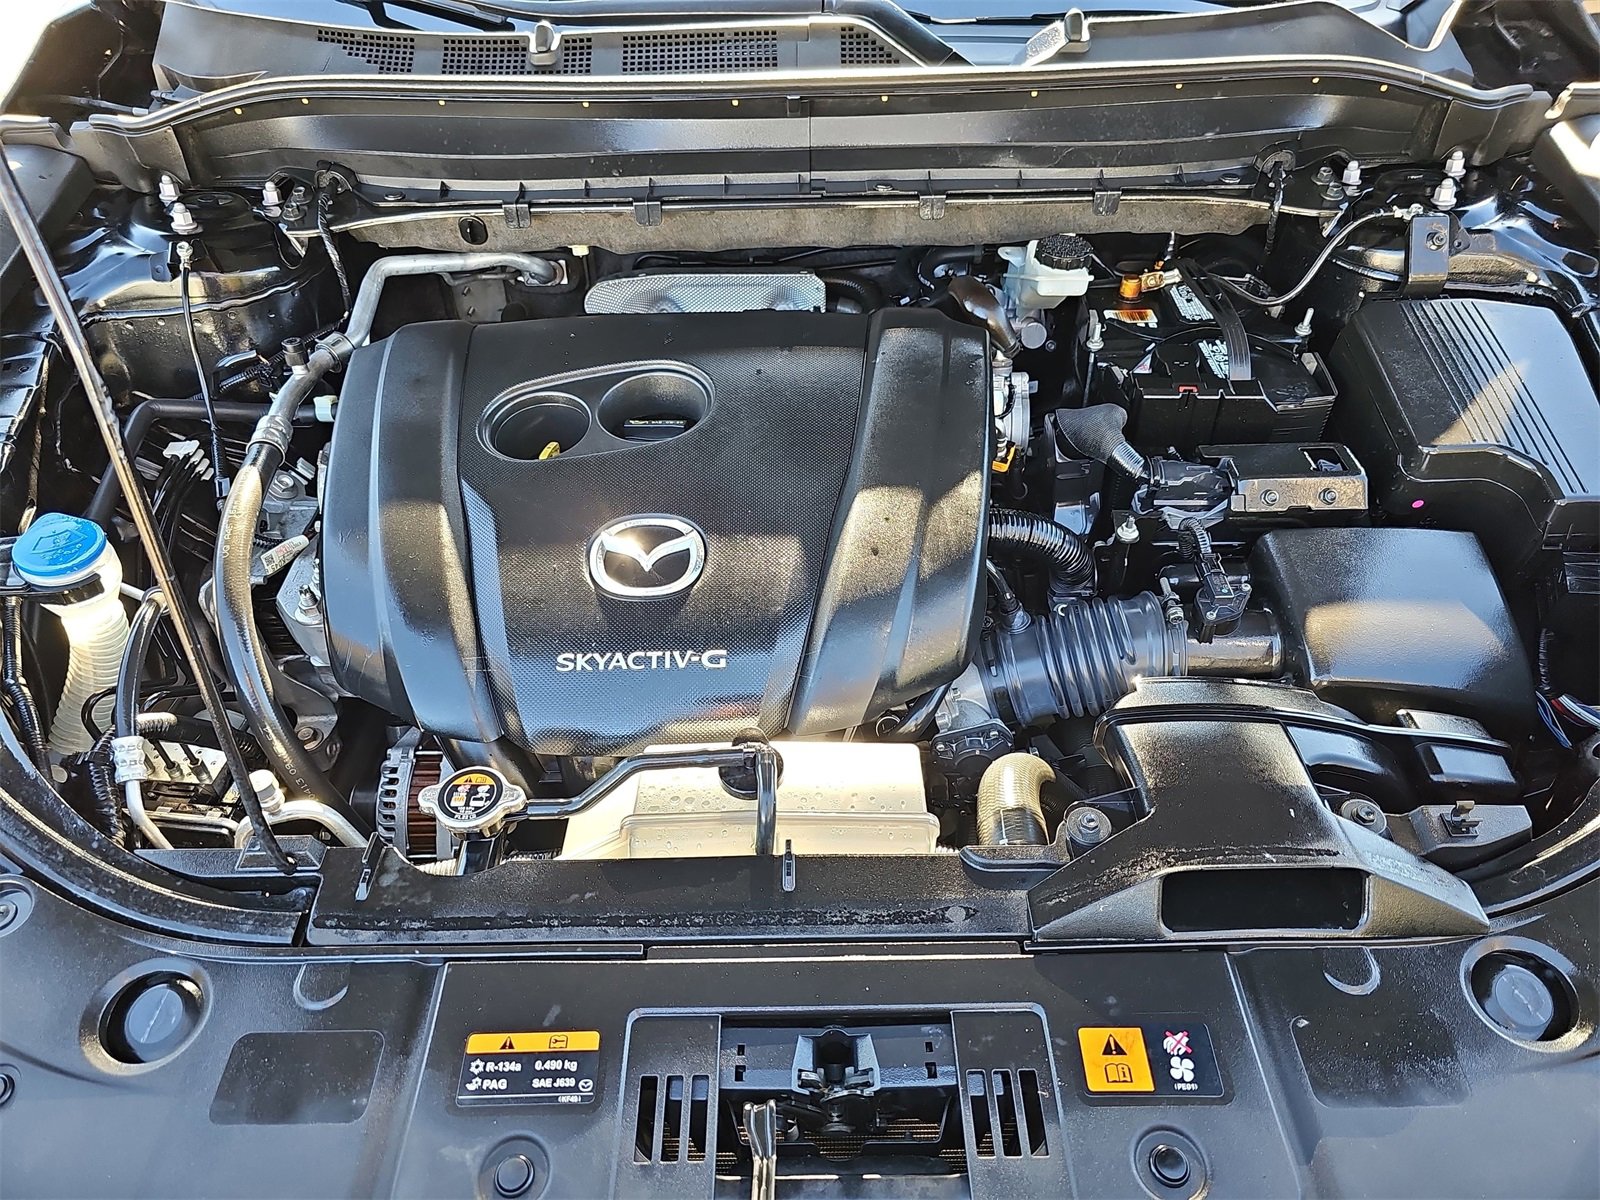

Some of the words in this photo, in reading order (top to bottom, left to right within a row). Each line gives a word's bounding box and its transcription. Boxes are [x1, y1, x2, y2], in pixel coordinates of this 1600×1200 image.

[555, 649, 728, 672] SKYACTIV-G
[485, 1060, 522, 1073] R-134a
[534, 1060, 562, 1071] 0.490
[564, 1059, 578, 1072] kg
[482, 1078, 508, 1090] PAG
[532, 1078, 552, 1088] SAE
